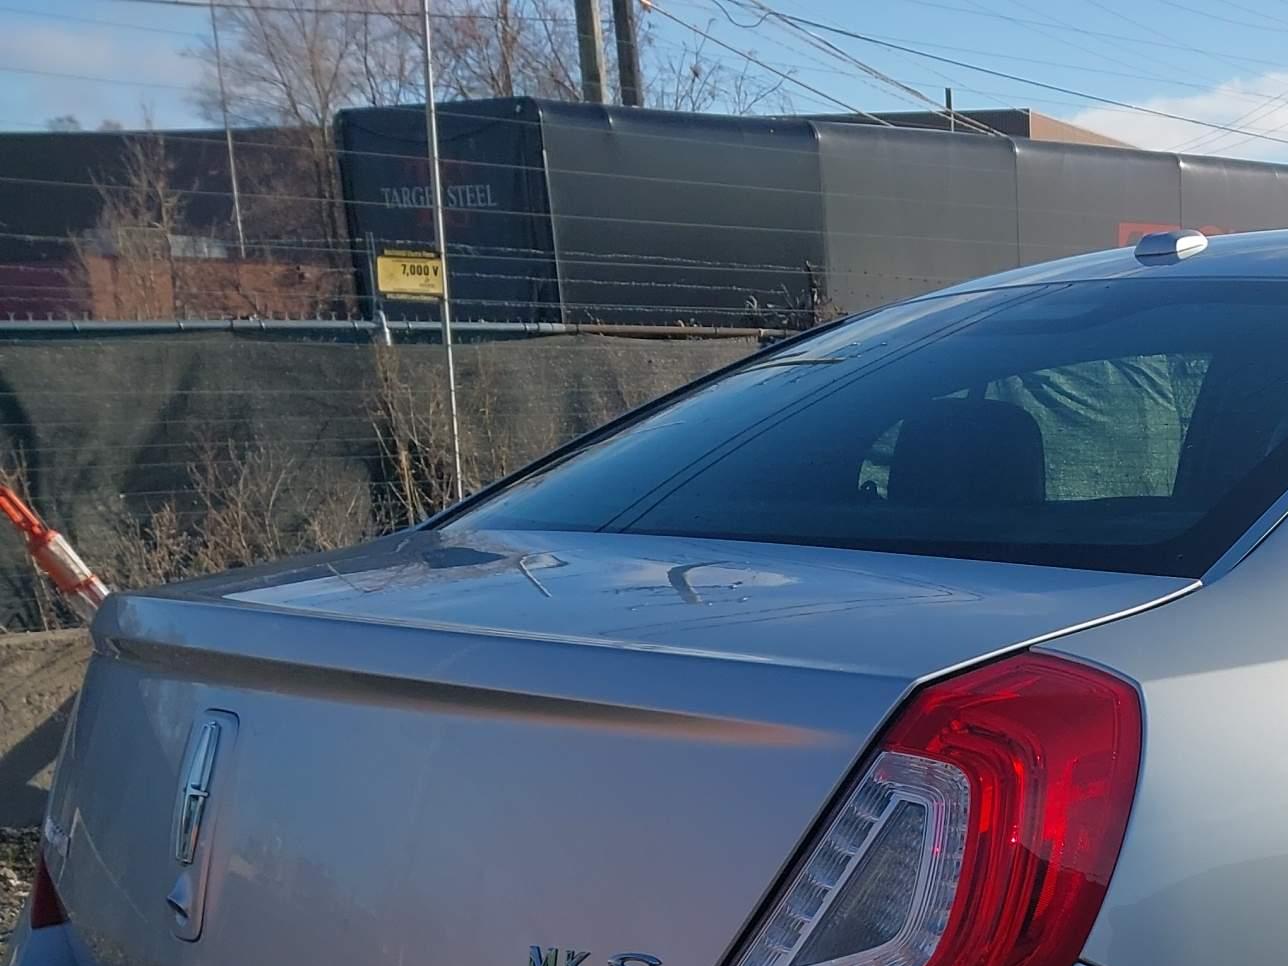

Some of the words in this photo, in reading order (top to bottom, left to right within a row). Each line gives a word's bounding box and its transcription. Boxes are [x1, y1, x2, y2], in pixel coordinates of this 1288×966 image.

[381, 186, 444, 208] TARGE
[447, 184, 497, 208] STEEL
[401, 263, 429, 277] 7,000
[432, 265, 439, 277] V
